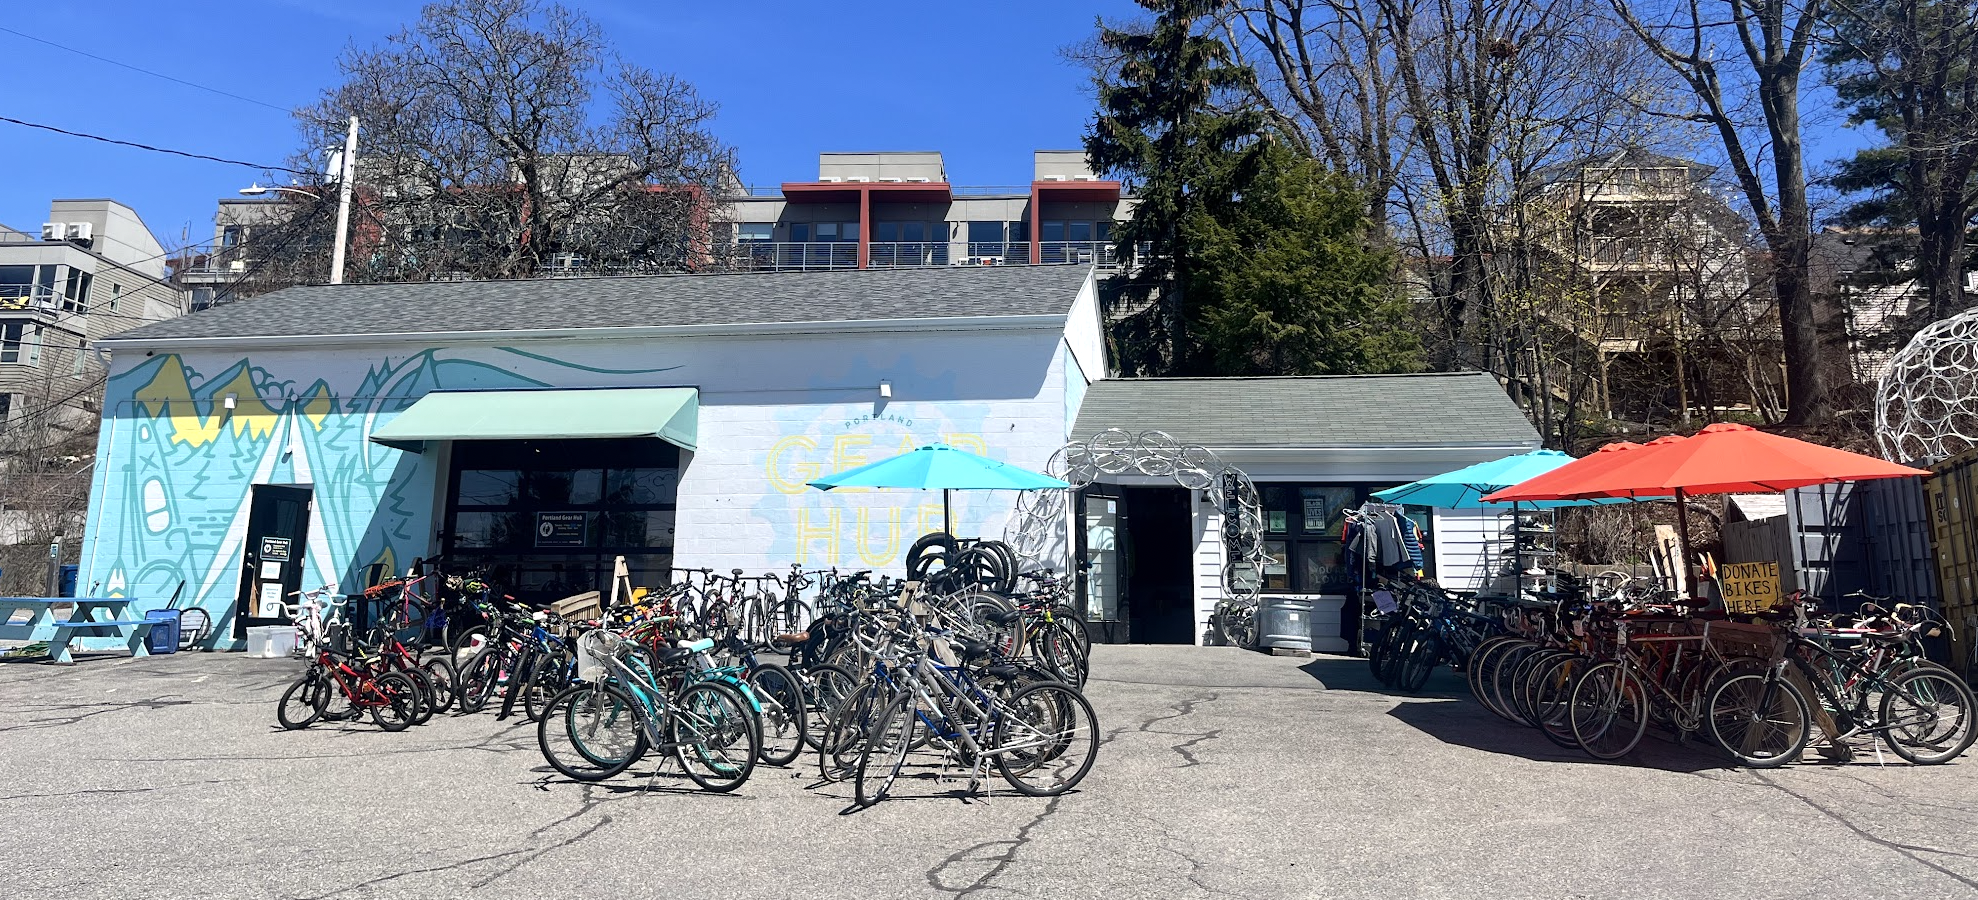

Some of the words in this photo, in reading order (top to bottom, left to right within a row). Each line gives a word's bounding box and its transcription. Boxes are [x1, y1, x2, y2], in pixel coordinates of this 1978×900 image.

[1223, 474, 1243, 564] WELCOME
[1306, 508, 1322, 516] LIVES
[1723, 562, 1778, 579] DONATE
[1725, 580, 1771, 597] BIKES
[1727, 600, 1762, 612] HERE
